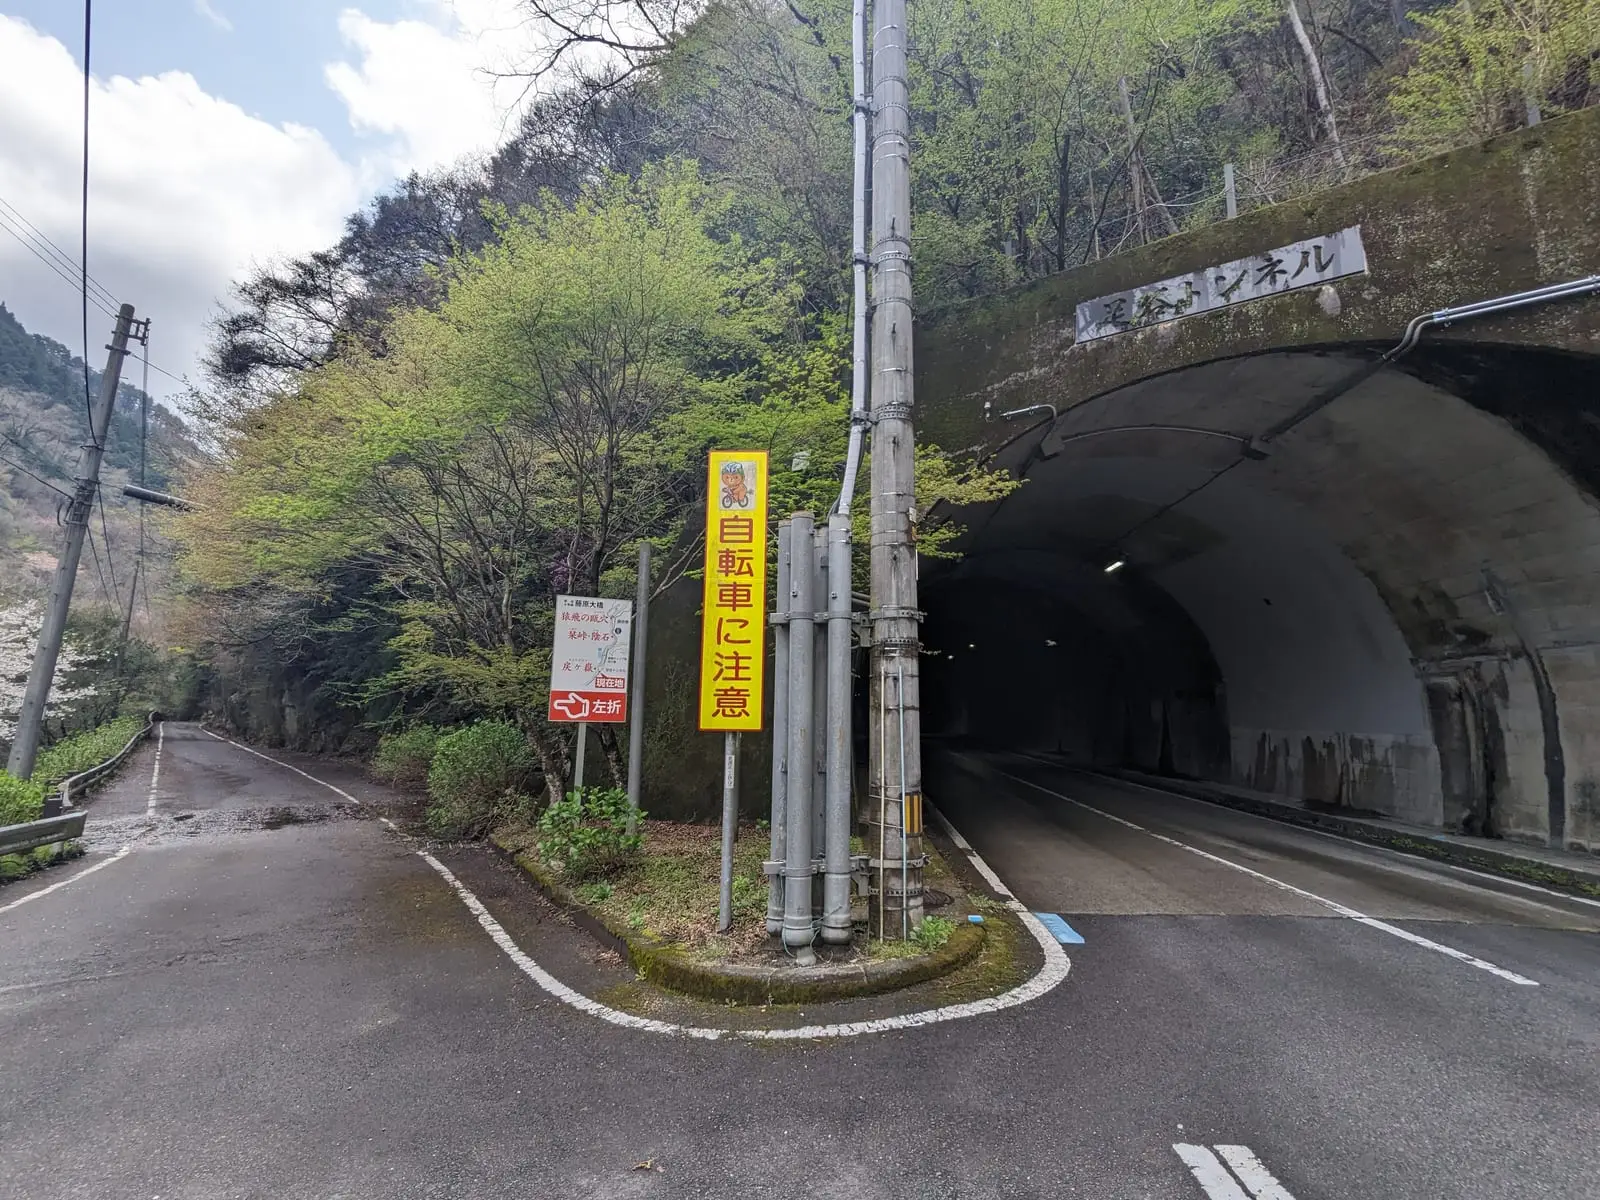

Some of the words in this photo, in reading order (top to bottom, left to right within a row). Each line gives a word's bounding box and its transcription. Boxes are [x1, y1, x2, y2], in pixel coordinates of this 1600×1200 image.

[712, 515, 754, 718] 自転車に注意
[596, 678, 624, 688] 現在地
[592, 699, 622, 714] 左折
